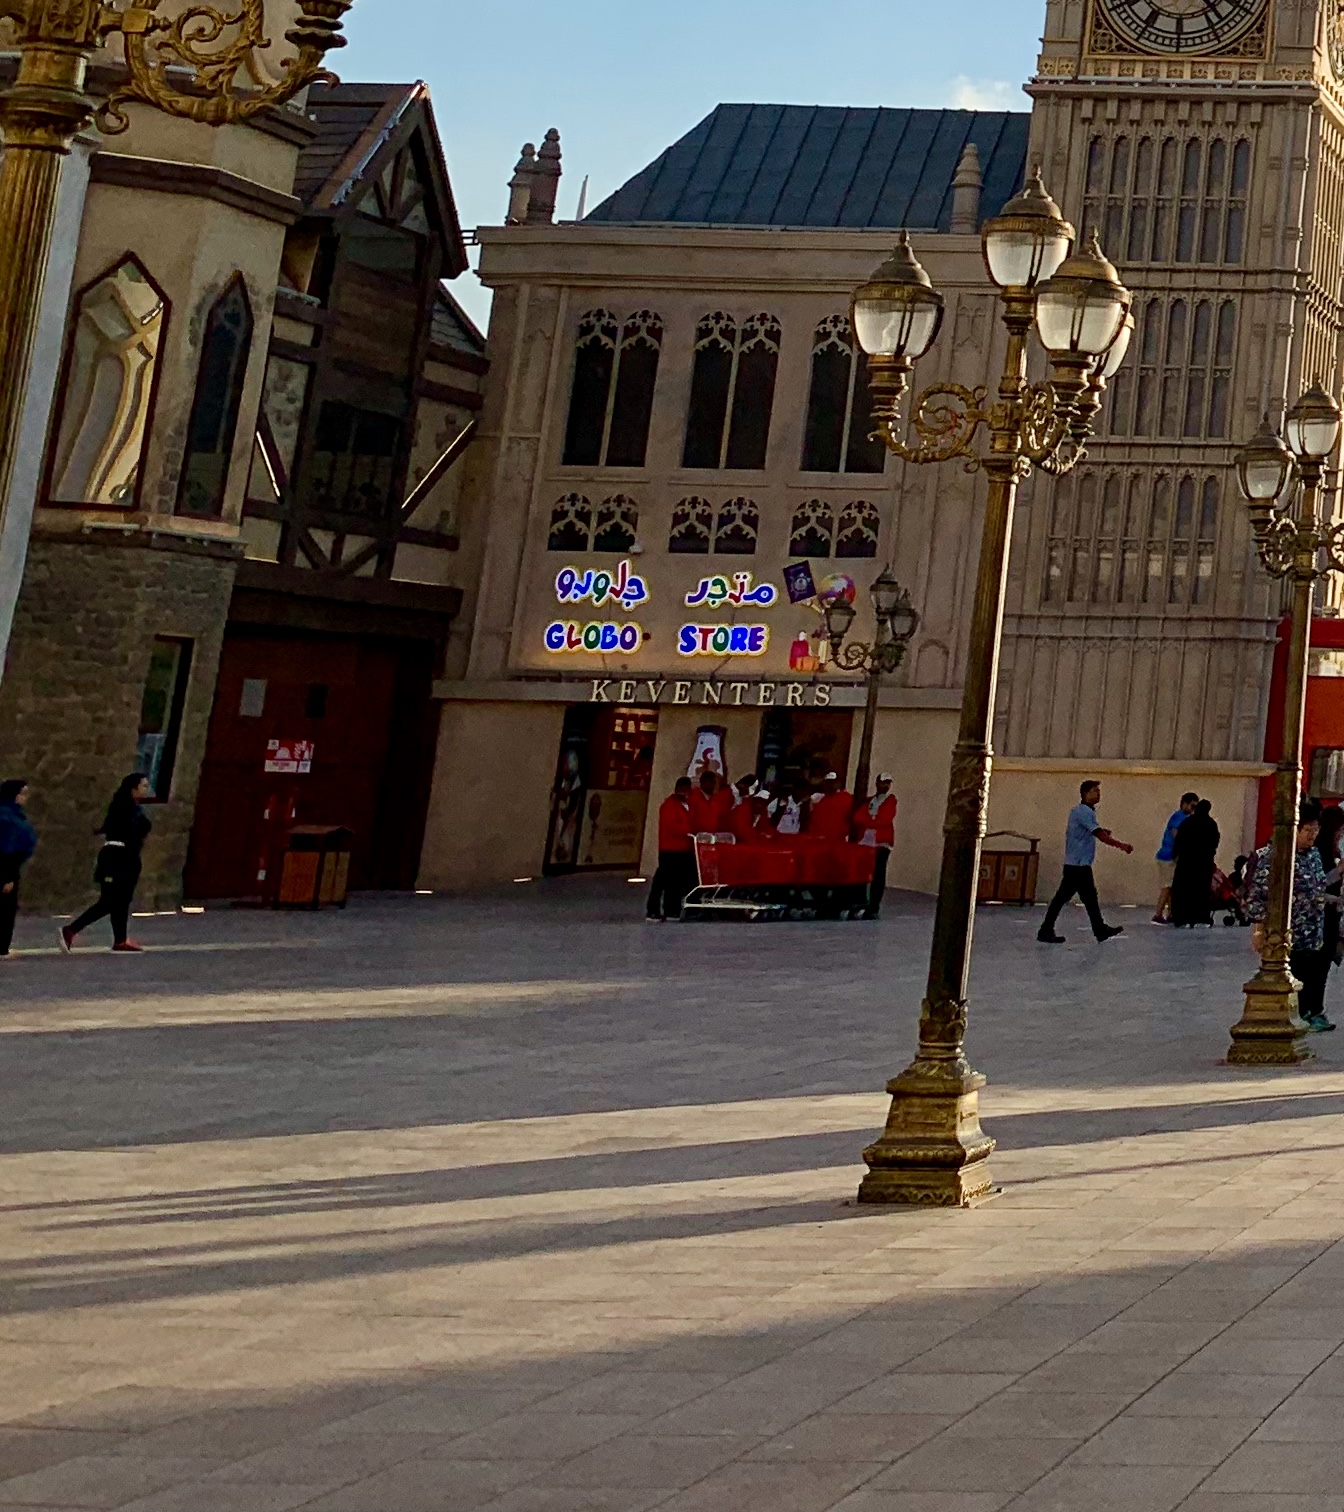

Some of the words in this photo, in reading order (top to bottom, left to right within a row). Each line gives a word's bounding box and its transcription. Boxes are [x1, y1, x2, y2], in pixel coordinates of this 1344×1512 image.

[556, 559, 648, 609] جلوبو
[686, 572, 776, 607] متجر
[545, 622, 639, 651] GLOBO
[678, 624, 766, 654] STORE
[589, 678, 833, 707] KEVENTERS
